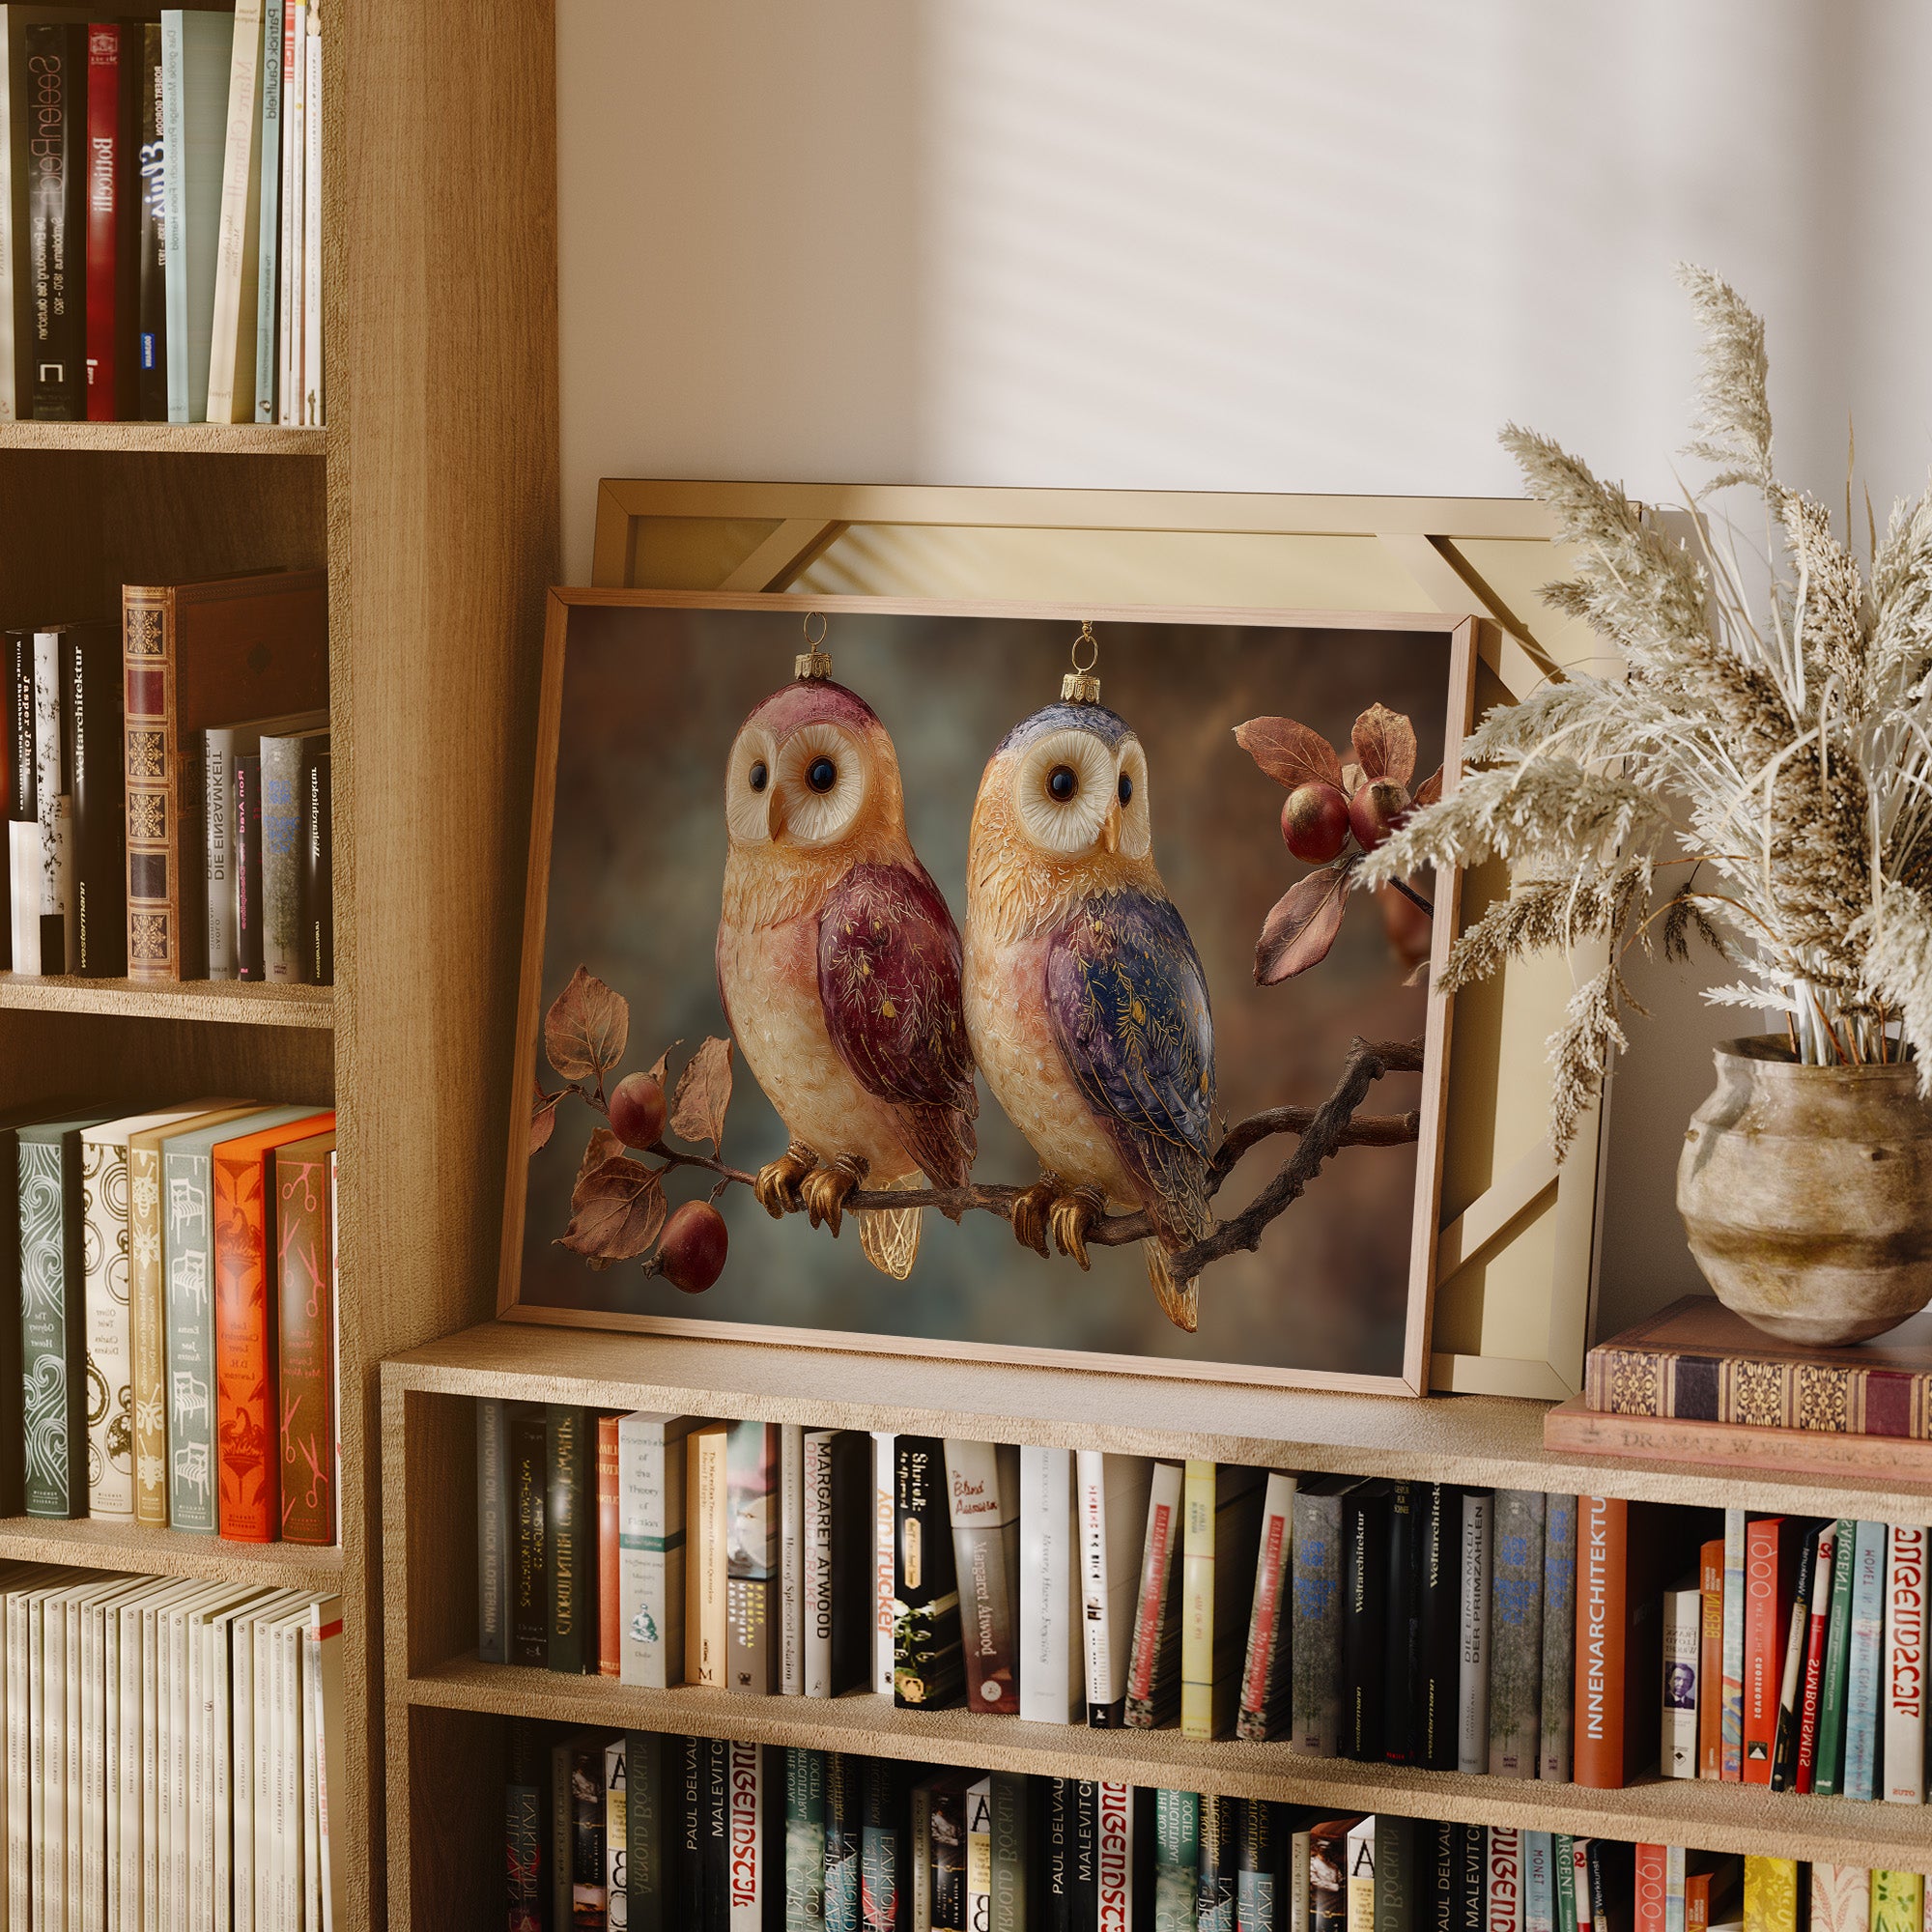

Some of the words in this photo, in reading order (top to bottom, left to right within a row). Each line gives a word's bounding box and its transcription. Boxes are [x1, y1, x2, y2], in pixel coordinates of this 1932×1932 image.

[74, 646, 84, 782] Weltarchitektur
[1622, 1430, 1719, 1454] DRAMAT
[1732, 1438, 1753, 1455] W
[806, 1441, 817, 1492] ORYX
[954, 1481, 983, 1496] Blind
[629, 1485, 659, 1497] Theory
[817, 1443, 831, 1551] MARGARET
[806, 1500, 816, 1539] AND
[806, 1547, 816, 1611] CRAKE
[972, 1541, 988, 1600] Margaret
[1355, 1511, 1364, 1612] Weltarchitektur
[817, 1557, 831, 1639] ATWOOD
[979, 1605, 996, 1656] Atwood
[697, 1668, 713, 1680] M
[687, 1807, 696, 1851] PAUL
[1053, 1852, 1064, 1894] PAUL
[1533, 1850, 1544, 1885] MONET
[1592, 1861, 1603, 1907] Werkkunst
[1636, 1857, 1662, 1918] 1900
[1535, 1891, 1544, 1901] IN
